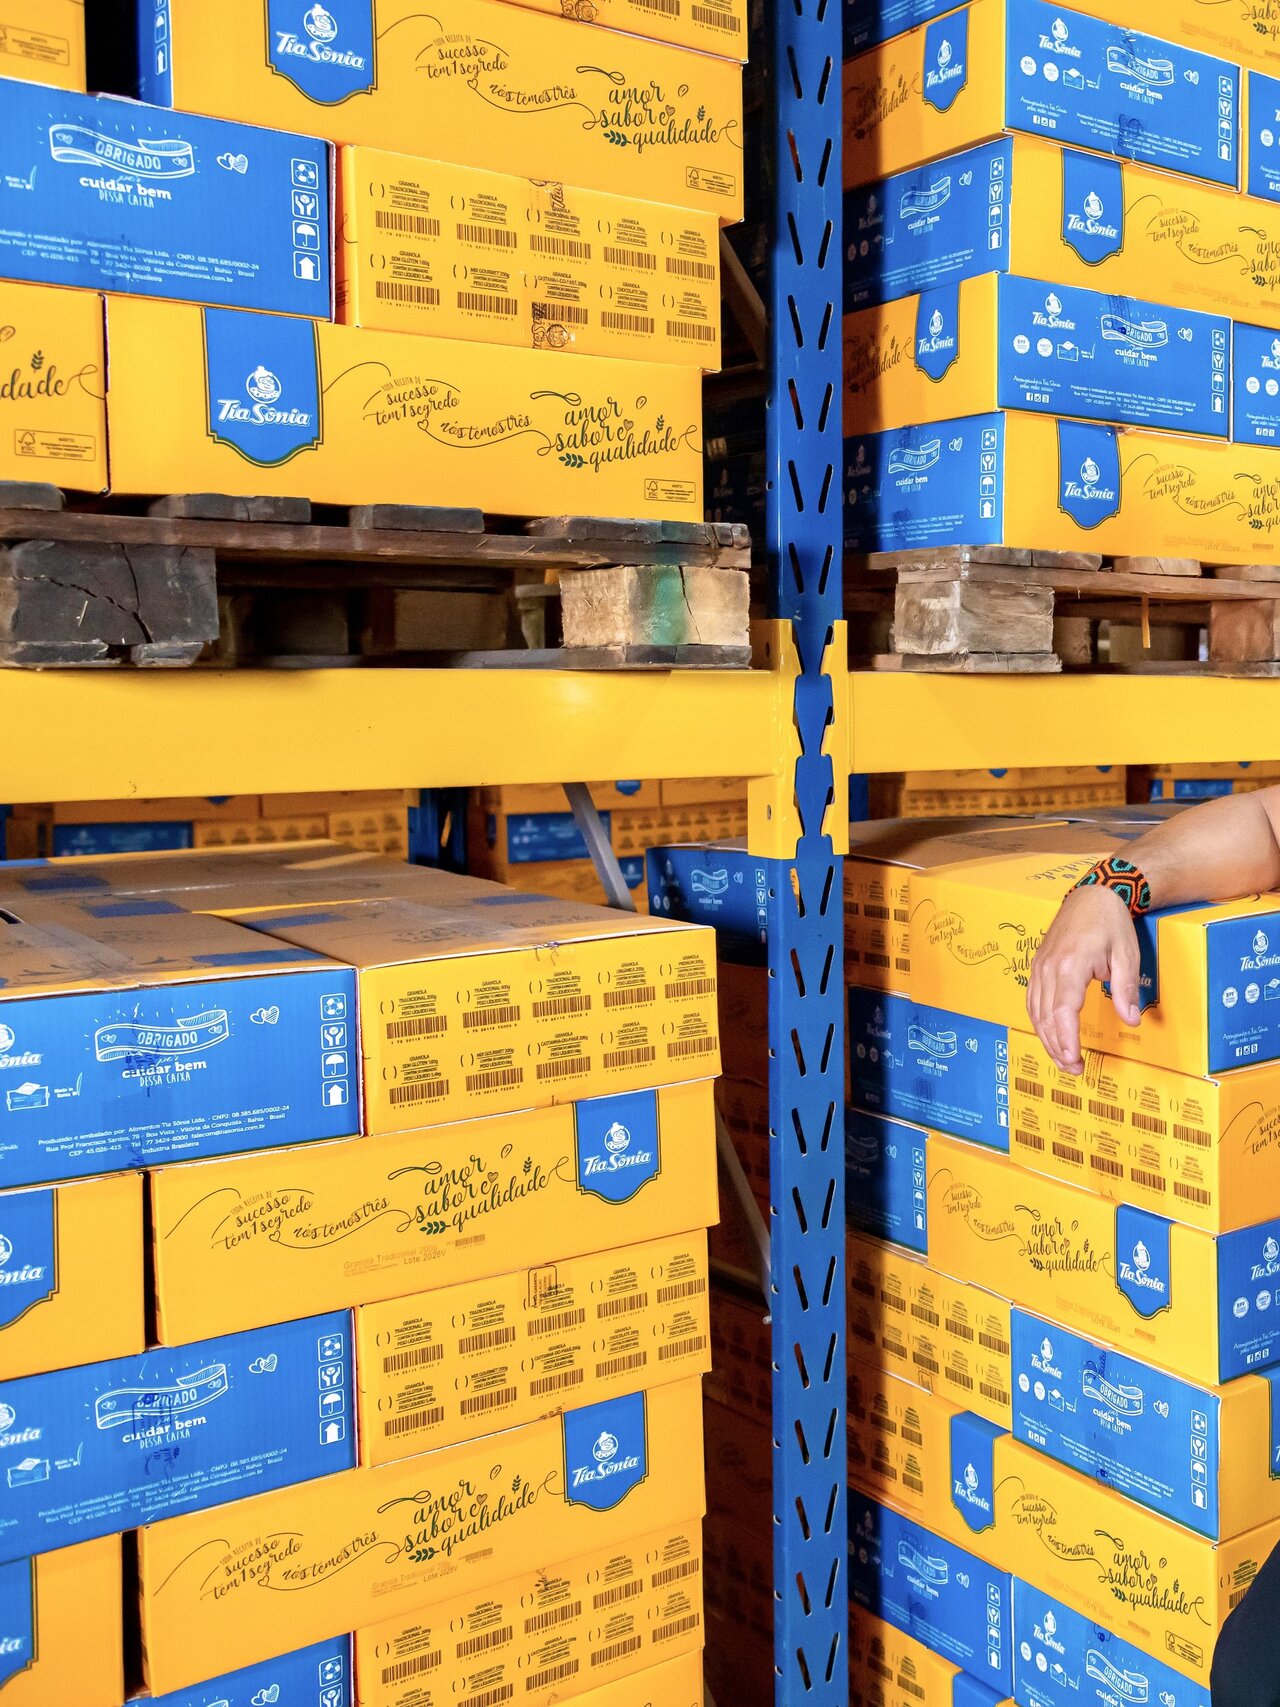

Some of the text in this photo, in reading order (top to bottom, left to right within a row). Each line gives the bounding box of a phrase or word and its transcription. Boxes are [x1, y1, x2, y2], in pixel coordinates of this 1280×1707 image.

[275, 31, 366, 71] Tia Sônia
[438, 45, 488, 60] sucesso
[1038, 34, 1082, 59] Tia Sônia
[926, 69, 941, 88] Tia
[608, 80, 665, 105] amor
[1146, 86, 1163, 100] bem
[633, 118, 719, 154] qualidade
[95, 141, 161, 171] OBRIGADO
[79, 175, 172, 200] cuidar bem
[398, 180, 420, 188] GRANOLA
[99, 189, 154, 209] DESSA CAIXA
[478, 193, 497, 201] GRANOLA
[1067, 213, 1119, 239] Tia Sônia
[399, 250, 421, 258] GRANOLA
[1032, 312, 1076, 330] Tia Sônia
[918, 339, 933, 355] Tia
[1115, 348, 1157, 362] cuidar bem
[387, 385, 438, 406] sucesso
[217, 399, 312, 427] Tia Sônia
[564, 397, 623, 426] amor
[589, 426, 677, 473] qualidade
[1064, 481, 1115, 500] Tia Sônia
[1240, 954, 1280, 971] Tia Sônia
[137, 1030, 198, 1047] OBRIGADO
[0, 1051, 43, 1069] ônia
[121, 1060, 207, 1079] cuidar bem
[140, 1071, 191, 1087] DESSA CAIXA
[38, 1136, 73, 1145] Produzido
[80, 1130, 113, 1140] embalado
[128, 1124, 161, 1133] Alimentos
[75, 1139, 107, 1148] Francisca
[211, 1119, 242, 1129] Conquista
[424, 1154, 486, 1195] amor
[583, 1150, 653, 1177] Tia Sônia
[452, 1165, 547, 1233] qualidade
[236, 1195, 290, 1228] sucesso
[1031, 1217, 1064, 1237] amor
[343, 1257, 374, 1270] Granola
[403, 1256, 421, 1266] Lote
[1046, 1250, 1098, 1278] qualidade
[1251, 1264, 1266, 1281] Tia
[1120, 1262, 1165, 1293] Tia Sônia
[1031, 1353, 1043, 1370] Tia
[1100, 1383, 1128, 1408] OBRIGADO
[122, 1415, 207, 1444] cuidar bem
[1092, 1408, 1132, 1432] cuidar bem
[140, 1430, 191, 1450] DESSA CAIXA
[572, 1456, 640, 1488] Tia Sônia
[414, 1479, 476, 1525] amor
[954, 1479, 990, 1512] Tia Sônia
[441, 1482, 536, 1557] qualidade
[225, 1538, 280, 1577] sucesso
[1114, 1550, 1150, 1572] amor
[1129, 1584, 1192, 1615] qualidade
[1033, 1624, 1045, 1641] Tia
[1104, 1666, 1133, 1695] OBRIGADO
